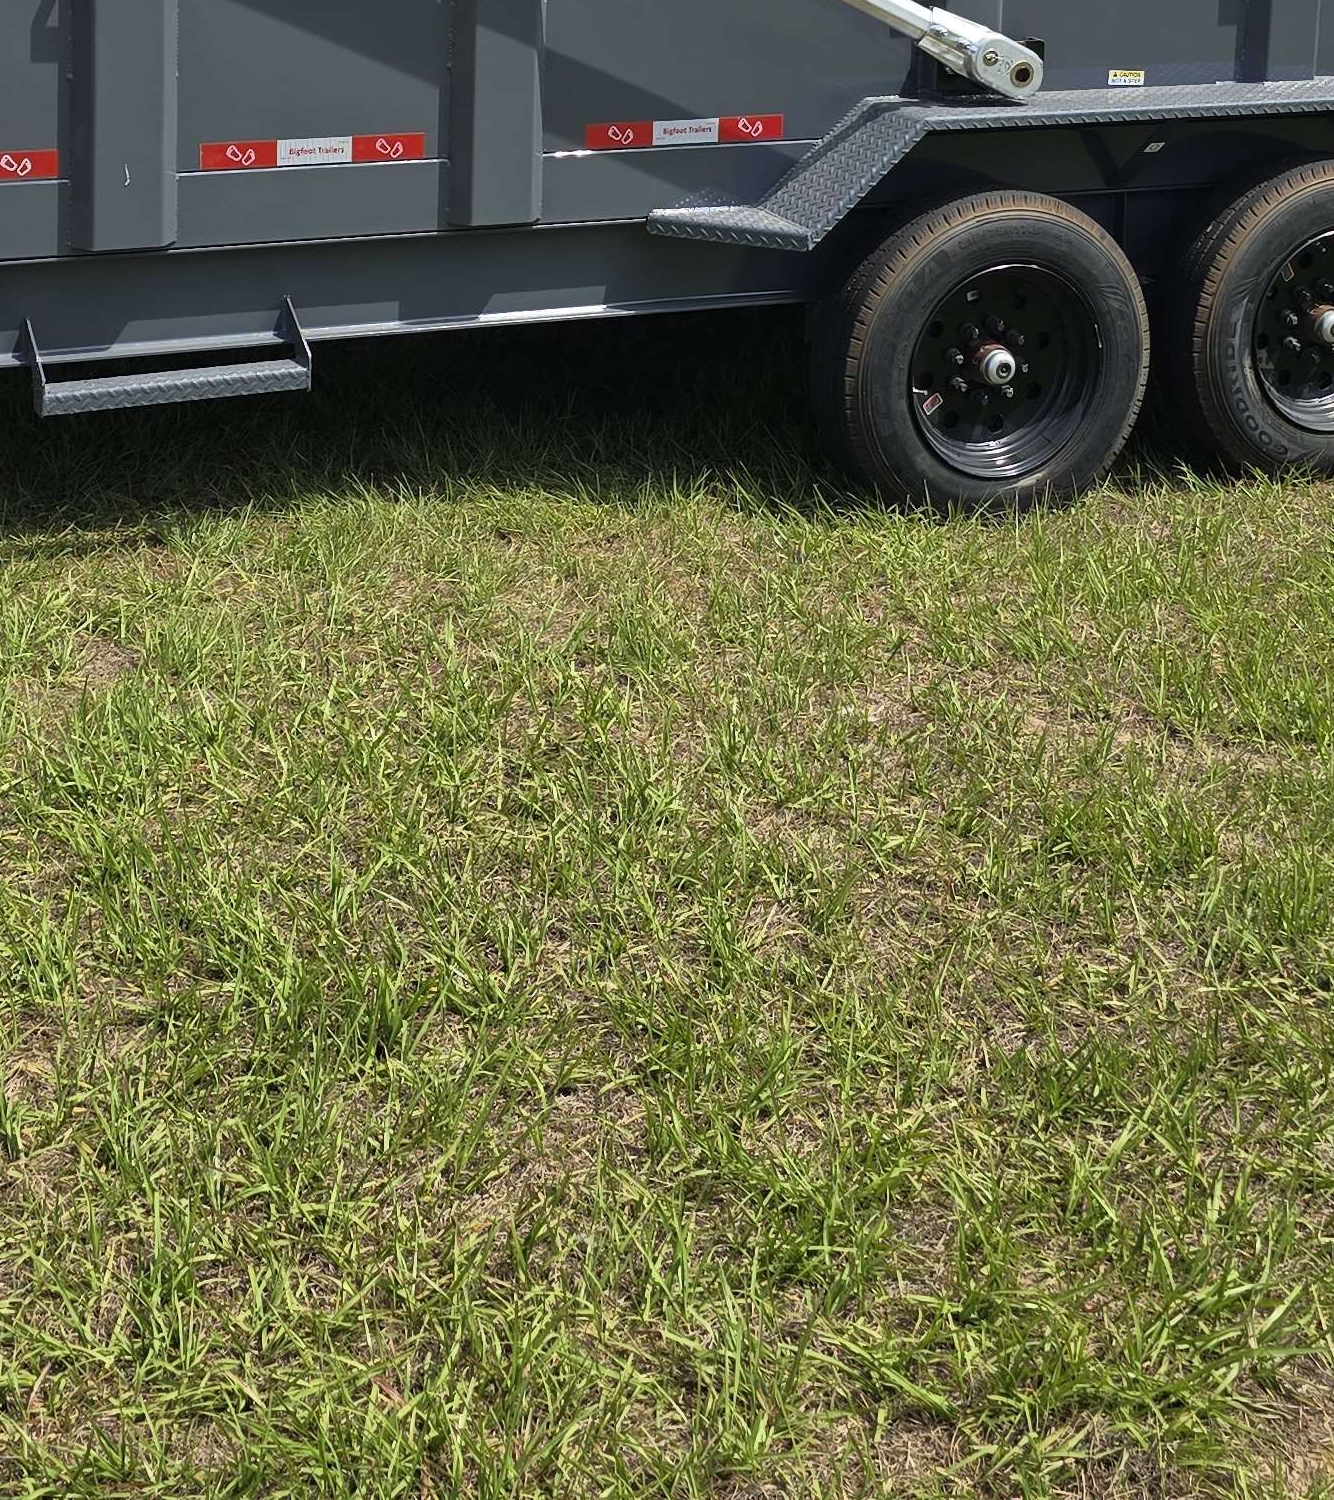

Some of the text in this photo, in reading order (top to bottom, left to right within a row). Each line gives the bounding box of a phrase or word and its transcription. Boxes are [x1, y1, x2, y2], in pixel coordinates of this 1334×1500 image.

[663, 127, 687, 135] Bigfoot
[289, 146, 345, 157] Bigfoot Trailers
